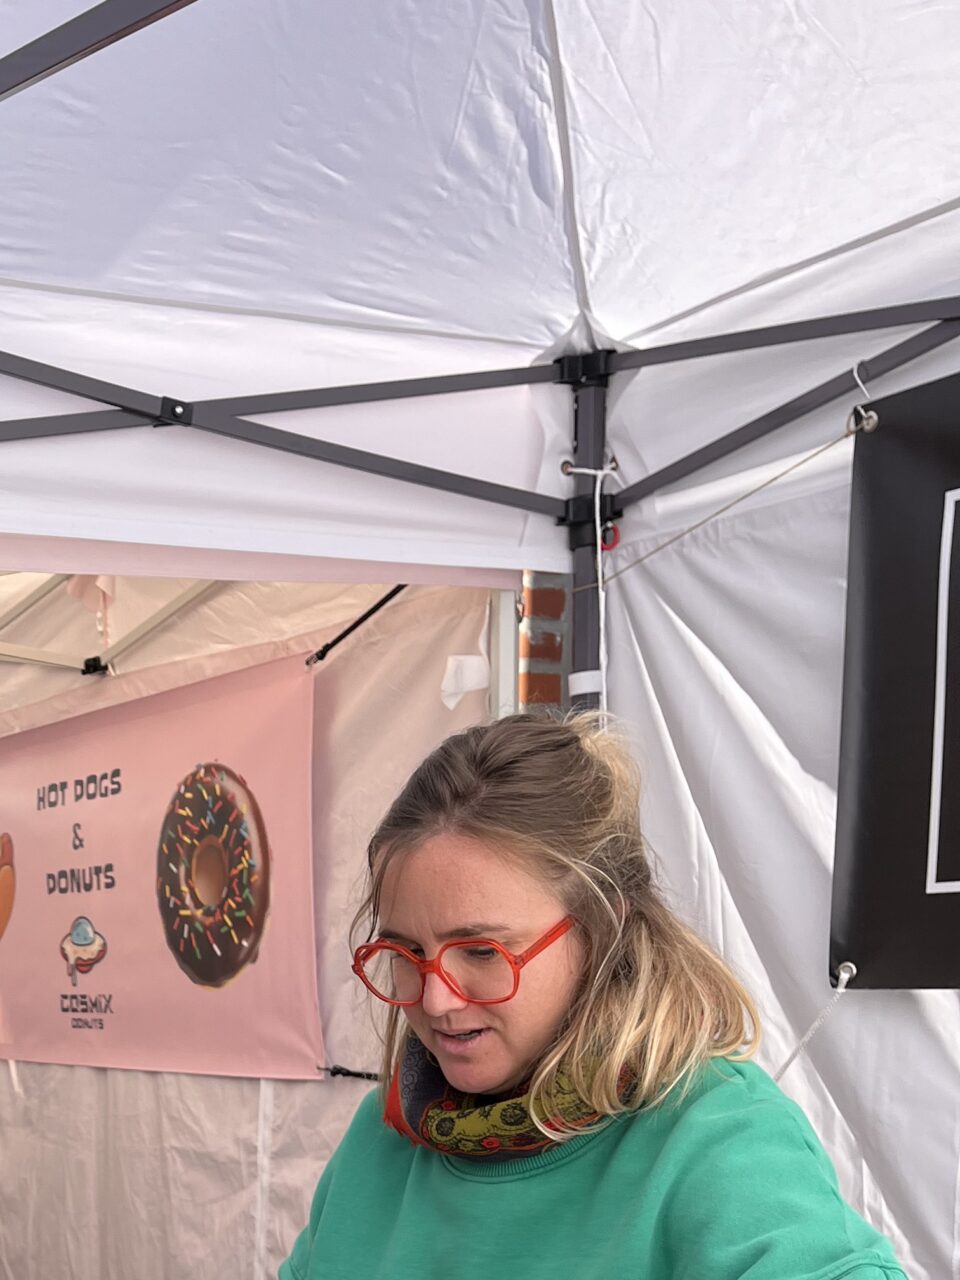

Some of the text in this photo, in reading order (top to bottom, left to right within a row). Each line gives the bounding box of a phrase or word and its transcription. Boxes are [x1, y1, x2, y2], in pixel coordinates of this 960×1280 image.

[37, 768, 122, 811] HOT DOGS
[72, 823, 84, 850] &
[47, 863, 115, 895] DONUTS
